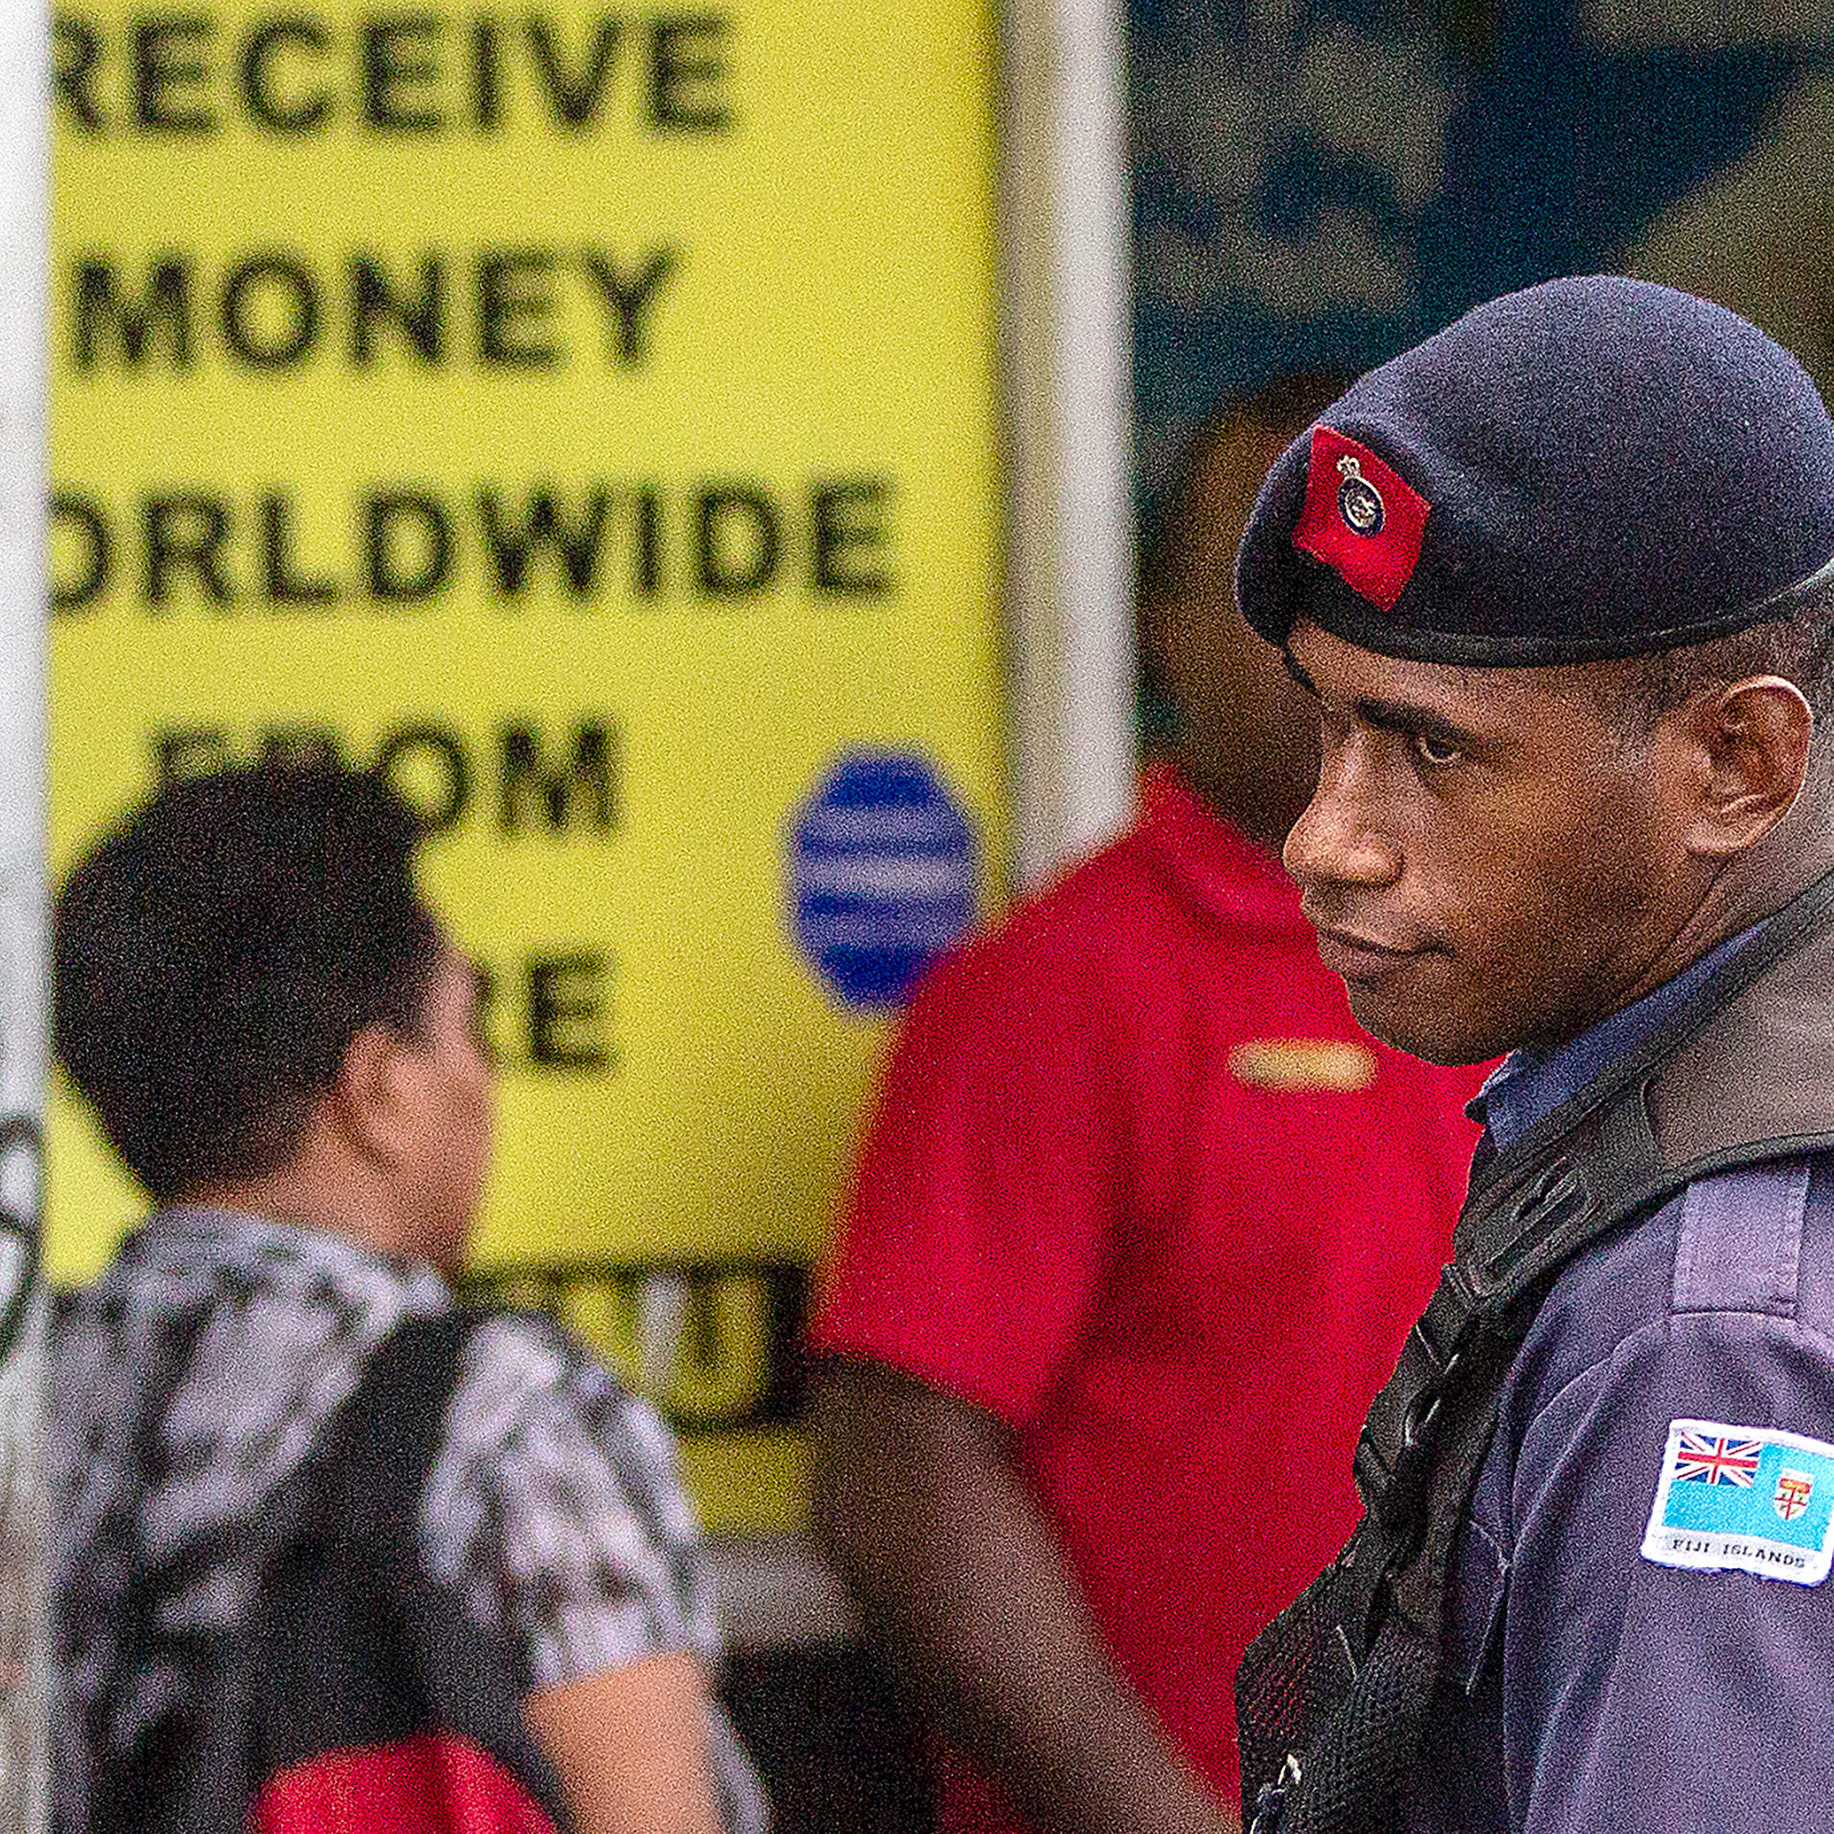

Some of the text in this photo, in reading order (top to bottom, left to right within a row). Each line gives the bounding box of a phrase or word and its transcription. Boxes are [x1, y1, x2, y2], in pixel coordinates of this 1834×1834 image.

[70, 243, 682, 375] MONEY
[47, 472, 899, 612] ORLDWIDE
[1672, 1539, 1807, 1569] FIJI ISLANDS
